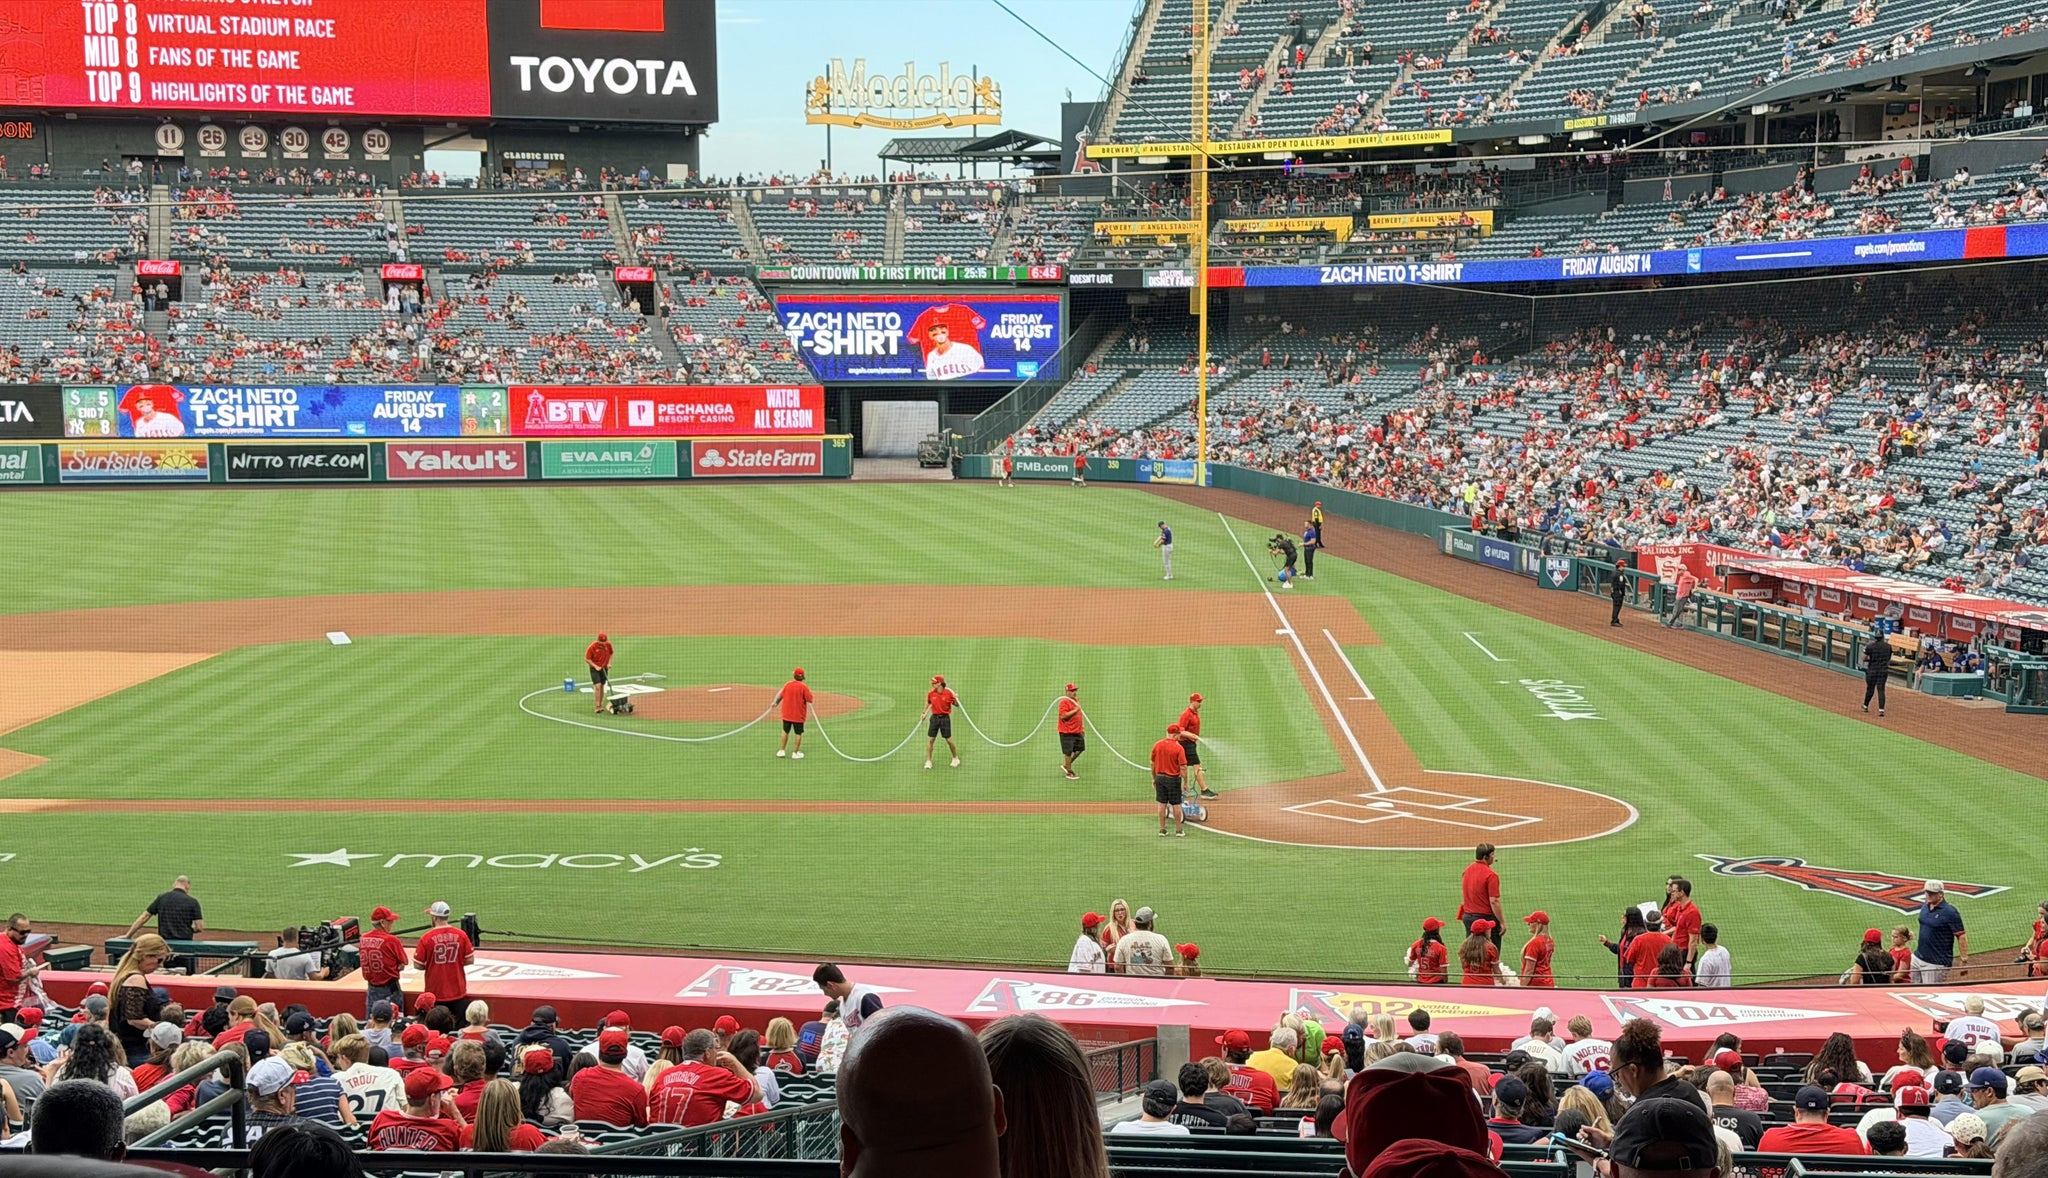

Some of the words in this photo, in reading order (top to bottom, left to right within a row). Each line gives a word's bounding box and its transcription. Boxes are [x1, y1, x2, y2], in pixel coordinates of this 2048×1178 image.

[82, 3, 118, 35] TOP
[125, 4, 138, 35] 8
[147, 14, 217, 35] VIRTUAL
[219, 16, 290, 37] STADIUM
[296, 19, 336, 38] RACE
[84, 36, 120, 68] MID
[125, 37, 138, 68] 8
[149, 47, 191, 67] FANS
[196, 49, 216, 67] OF
[222, 49, 252, 68] THE
[257, 50, 301, 69] GAME
[510, 55, 697, 96] TOYOTA
[86, 71, 122, 102] TOP
[129, 72, 141, 103] 9
[830, 58, 975, 109] Modelo
[151, 82, 247, 103] HIGHLIGHTS
[251, 84, 270, 103] OF
[275, 85, 307, 104] THE
[311, 86, 355, 105] GAME
[893, 120, 914, 129] 1925
[163, 129, 176, 144] 11
[202, 130, 222, 145] 26
[244, 131, 264, 146] 29
[285, 132, 304, 147] 30
[326, 133, 345, 148] 42
[367, 134, 386, 148] 50
[1392, 133, 1411, 142] ANGEL
[1413, 133, 1440, 141] STADIUM
[1218, 142, 1266, 151] RESTAURANT
[1268, 140, 1287, 149] OPEN
[1289, 139, 1298, 147] TO
[1300, 139, 1314, 147] ALL
[1315, 138, 1335, 147] FANS
[503, 152, 542, 160] CLASSIC
[543, 153, 565, 161] HITS
[1147, 222, 1167, 231] ANGEL
[1416, 215, 1435, 223] ANGEL
[1854, 239, 1925, 258] angels.com/promotions
[1562, 257, 1597, 276] FRIDAY
[1599, 255, 1638, 274] AUGUST
[1640, 254, 1651, 272] 14
[790, 266, 860, 280] COUNTDOWN
[863, 266, 877, 280] TO
[880, 266, 911, 280] FIRST
[914, 267, 946, 280] PITCH
[964, 268, 987, 279] 25:15
[1032, 267, 1056, 279] 6:45
[1097, 274, 1113, 284] LOVE
[1320, 265, 1363, 284] ZACH
[1366, 264, 1405, 282] NETO
[1408, 263, 1464, 281] T-SHIRT
[1148, 276, 1174, 287] DISNEY
[1175, 276, 1194, 287] FANS
[786, 312, 844, 330] ZACH
[847, 312, 901, 330] NETO
[1001, 313, 1043, 325] FRIDAY
[990, 324, 1053, 339] AUGUST
[785, 330, 903, 356] T-SHIRT
[1014, 338, 1031, 351] 14
[98, 391, 108, 406] 5
[189, 388, 243, 404] ZACH
[246, 388, 297, 404] NETO
[384, 391, 433, 403] FRIDAY
[491, 392, 501, 406] 2
[766, 389, 800, 408] WATCH
[0, 401, 34, 422] TA
[78, 407, 97, 418] END
[97, 407, 104, 418] 7
[189, 405, 299, 427] T-SHIRT
[373, 403, 447, 419] AUGUST
[482, 408, 488, 418] F
[658, 403, 734, 415] PECHANGA
[401, 418, 421, 433] 14
[658, 414, 695, 423] RESORT
[699, 414, 735, 423] CASINO
[754, 409, 771, 429] ALL
[773, 409, 813, 429] SEASON
[100, 420, 110, 434] 8
[494, 419, 501, 434] 1
[832, 439, 846, 448] 365
[68, 449, 153, 473] Surfside
[232, 453, 284, 469] NITTO
[288, 453, 365, 470] TIRE.COM
[396, 450, 517, 471] Yakult
[561, 451, 599, 462] EVA
[599, 451, 633, 462] AIR
[1016, 461, 1069, 473] FMB.com
[1107, 460, 1120, 469] 350
[1153, 461, 1164, 473] 811
[1641, 547, 1677, 556] SALINAS,
[1678, 546, 1695, 555] INC.
[1548, 559, 1569, 570] MLB
[1737, 591, 1769, 600] Yakult
[383, 847, 723, 873] macy's
[434, 942, 459, 964] 27
[747, 975, 810, 993] '82
[1031, 989, 1098, 1006] '86
[1662, 1005, 1737, 1022] '04
[1966, 1023, 1990, 1034] TROUT
[346, 1075, 379, 1089] TROUT
[658, 1086, 694, 1125] 17
[379, 1126, 439, 1151] HUNTER
